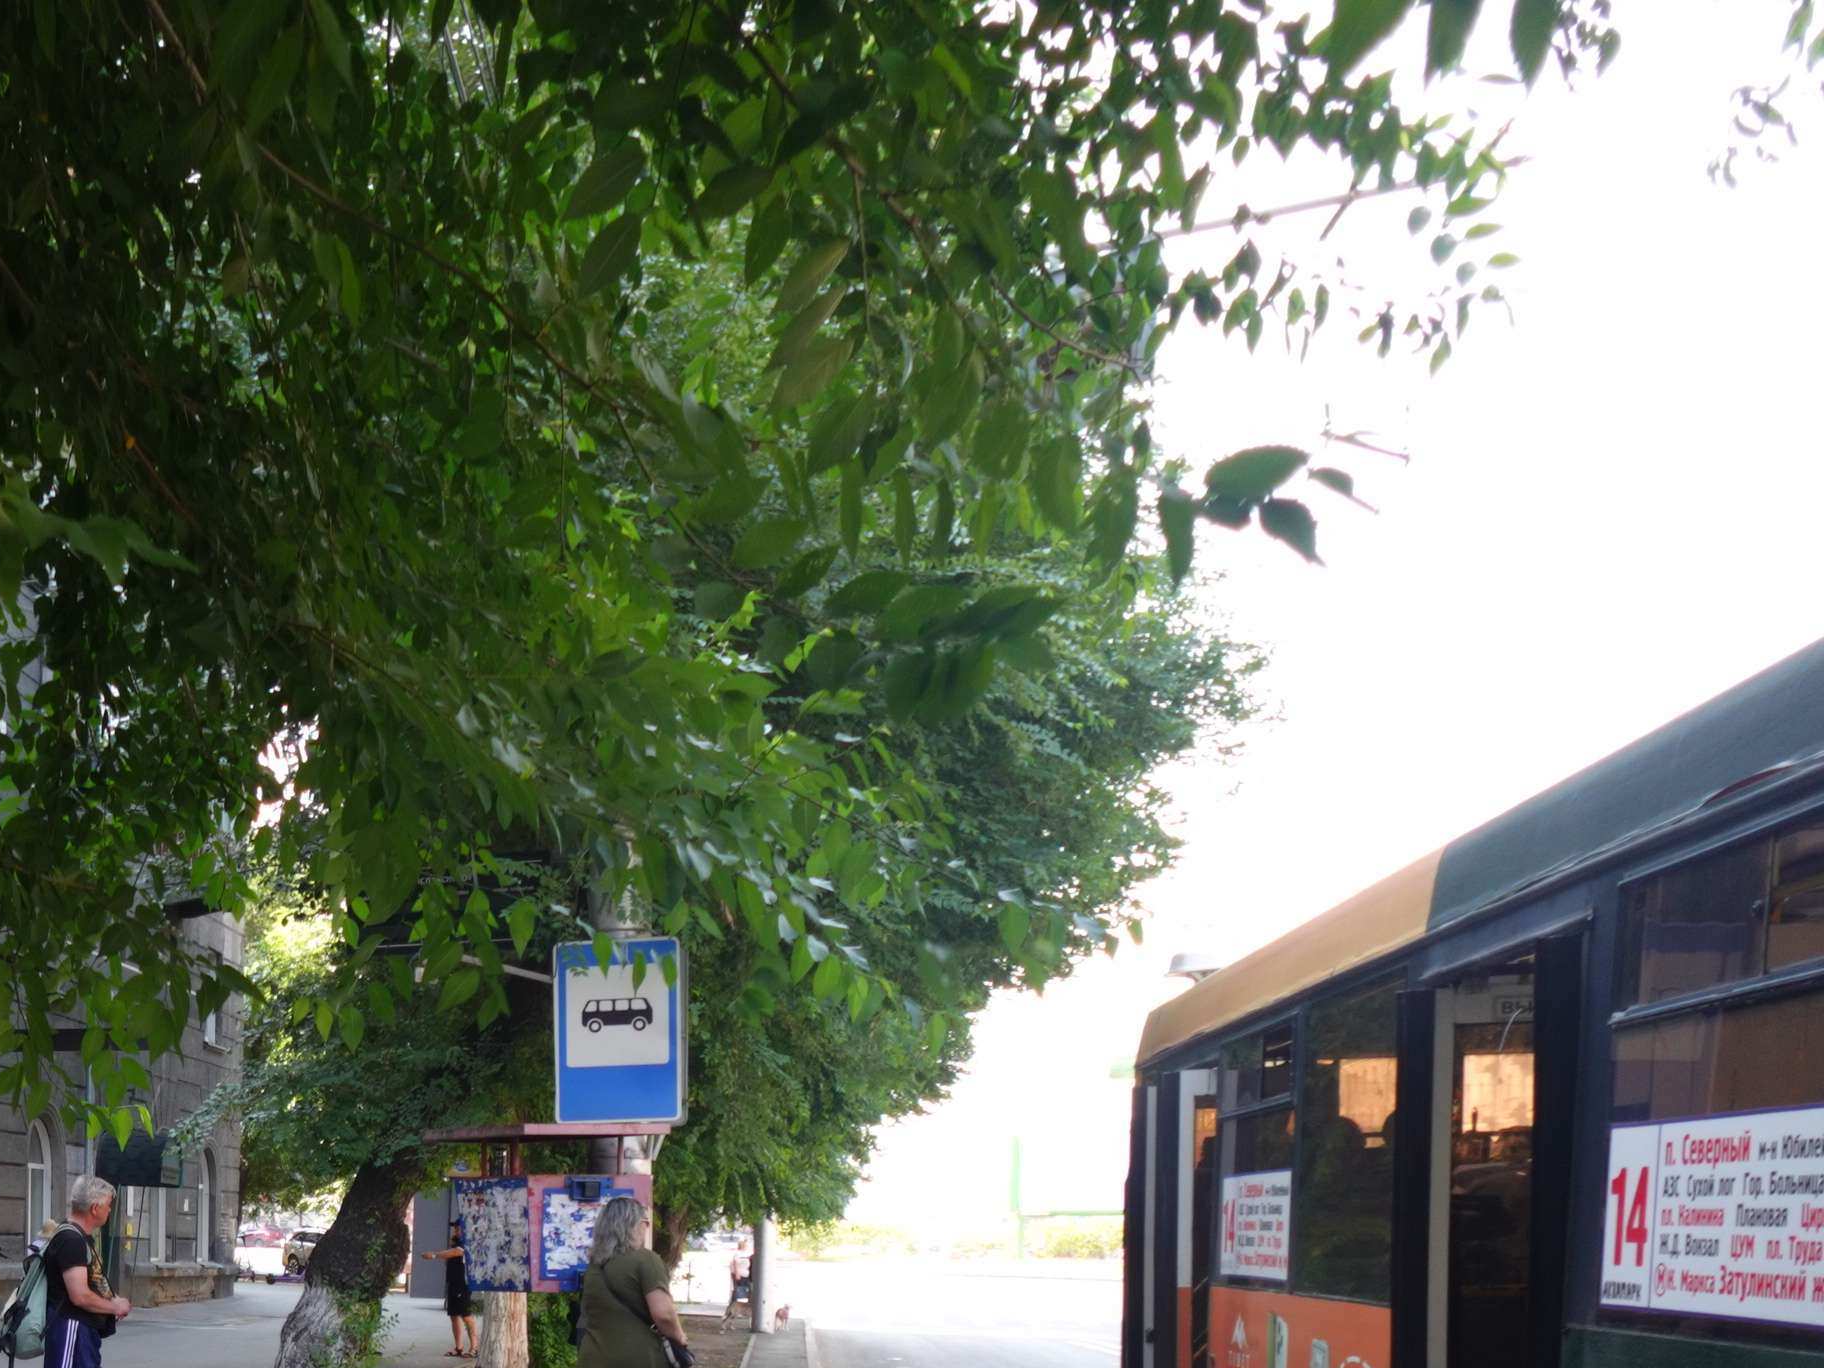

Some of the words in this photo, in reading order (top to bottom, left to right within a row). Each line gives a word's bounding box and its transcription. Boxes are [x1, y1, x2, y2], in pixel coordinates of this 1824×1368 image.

[1682, 1129, 1751, 1168] Северный
[1781, 1133, 1824, 1160] Юбиле
[1663, 1174, 1681, 1197] АЗС
[1687, 1174, 1714, 1201] Сухой
[1611, 1166, 1650, 1268] 14
[1678, 1204, 1725, 1227] Калинина
[1735, 1203, 1788, 1228] Плановая
[1684, 1233, 1720, 1258] Вокзал
[1730, 1234, 1756, 1262] ЦУМ
[1788, 1235, 1823, 1266] Труда
[1680, 1269, 1716, 1296] Маркса
[1718, 1265, 1807, 1303] Затулинский
